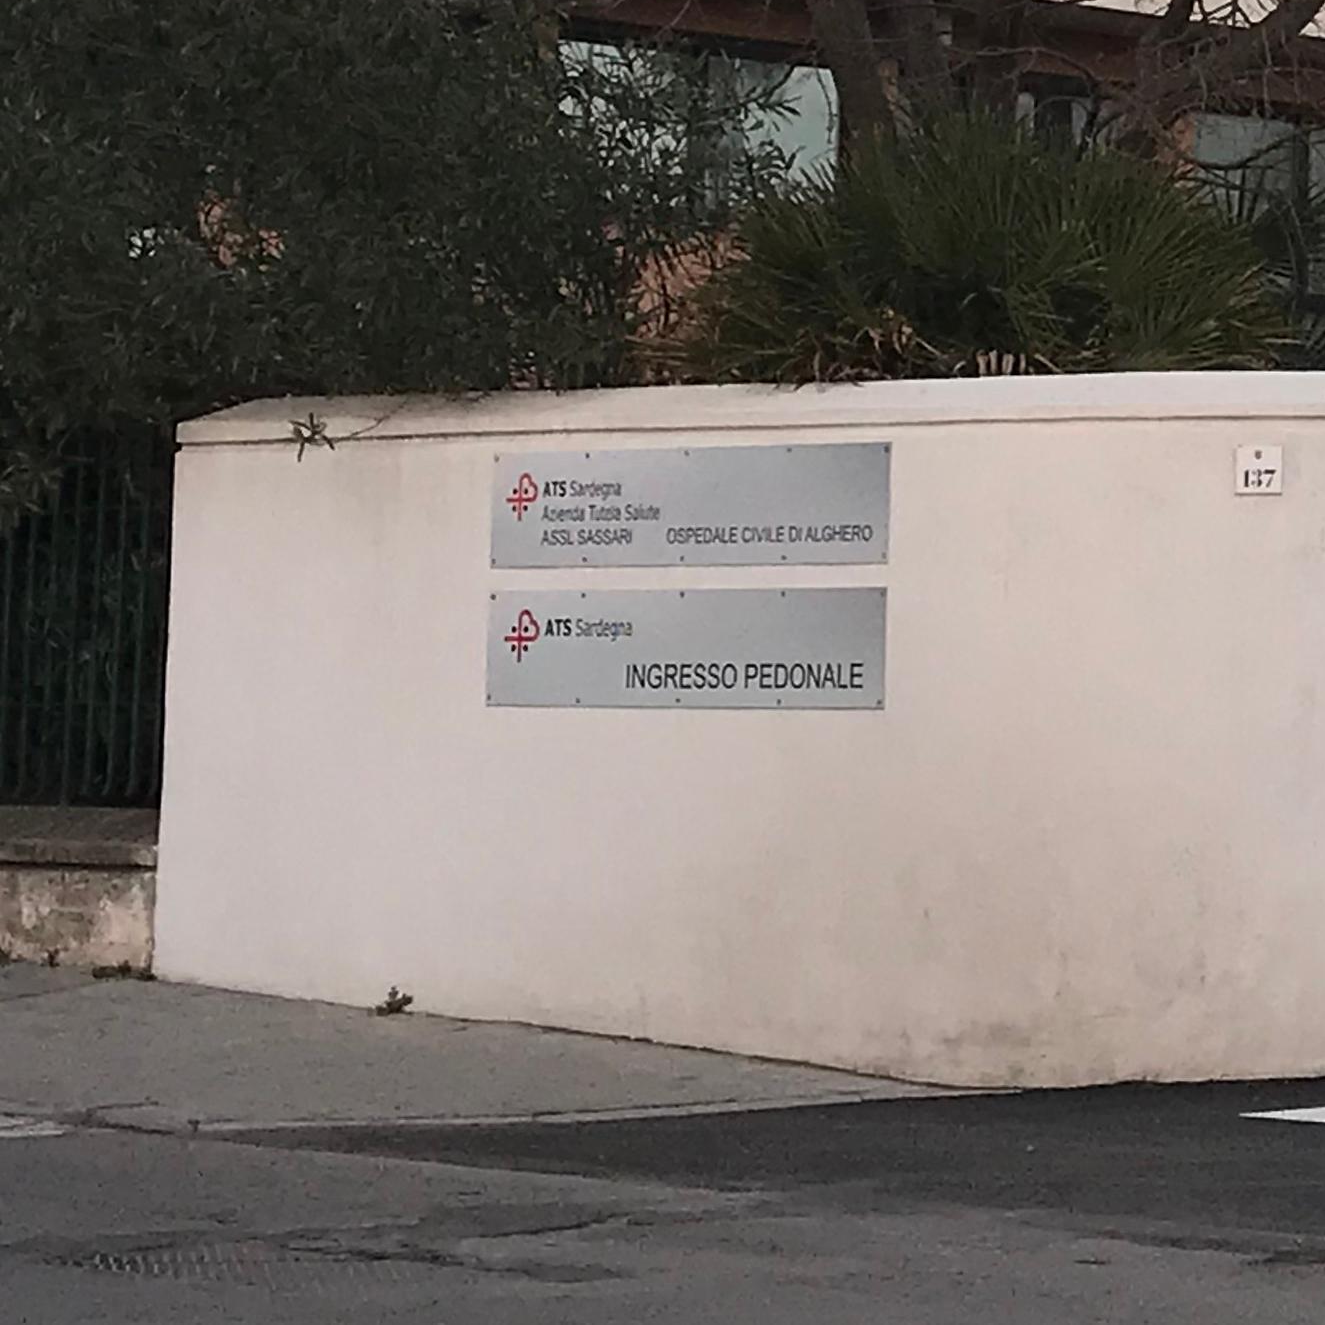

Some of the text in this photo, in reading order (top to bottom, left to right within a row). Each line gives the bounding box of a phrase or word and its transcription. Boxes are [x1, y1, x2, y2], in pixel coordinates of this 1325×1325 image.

[1243, 468, 1277, 488] 137
[542, 479, 622, 501] ATS Sardegna
[624, 503, 660, 521] Salute
[541, 527, 633, 547] ASSL SASSARI
[665, 523, 874, 545] OSPEDALE CIVILE DI ALGHERO
[544, 617, 633, 642] ATS Sardegna
[624, 662, 865, 690] INGRESSO PEDONALE
